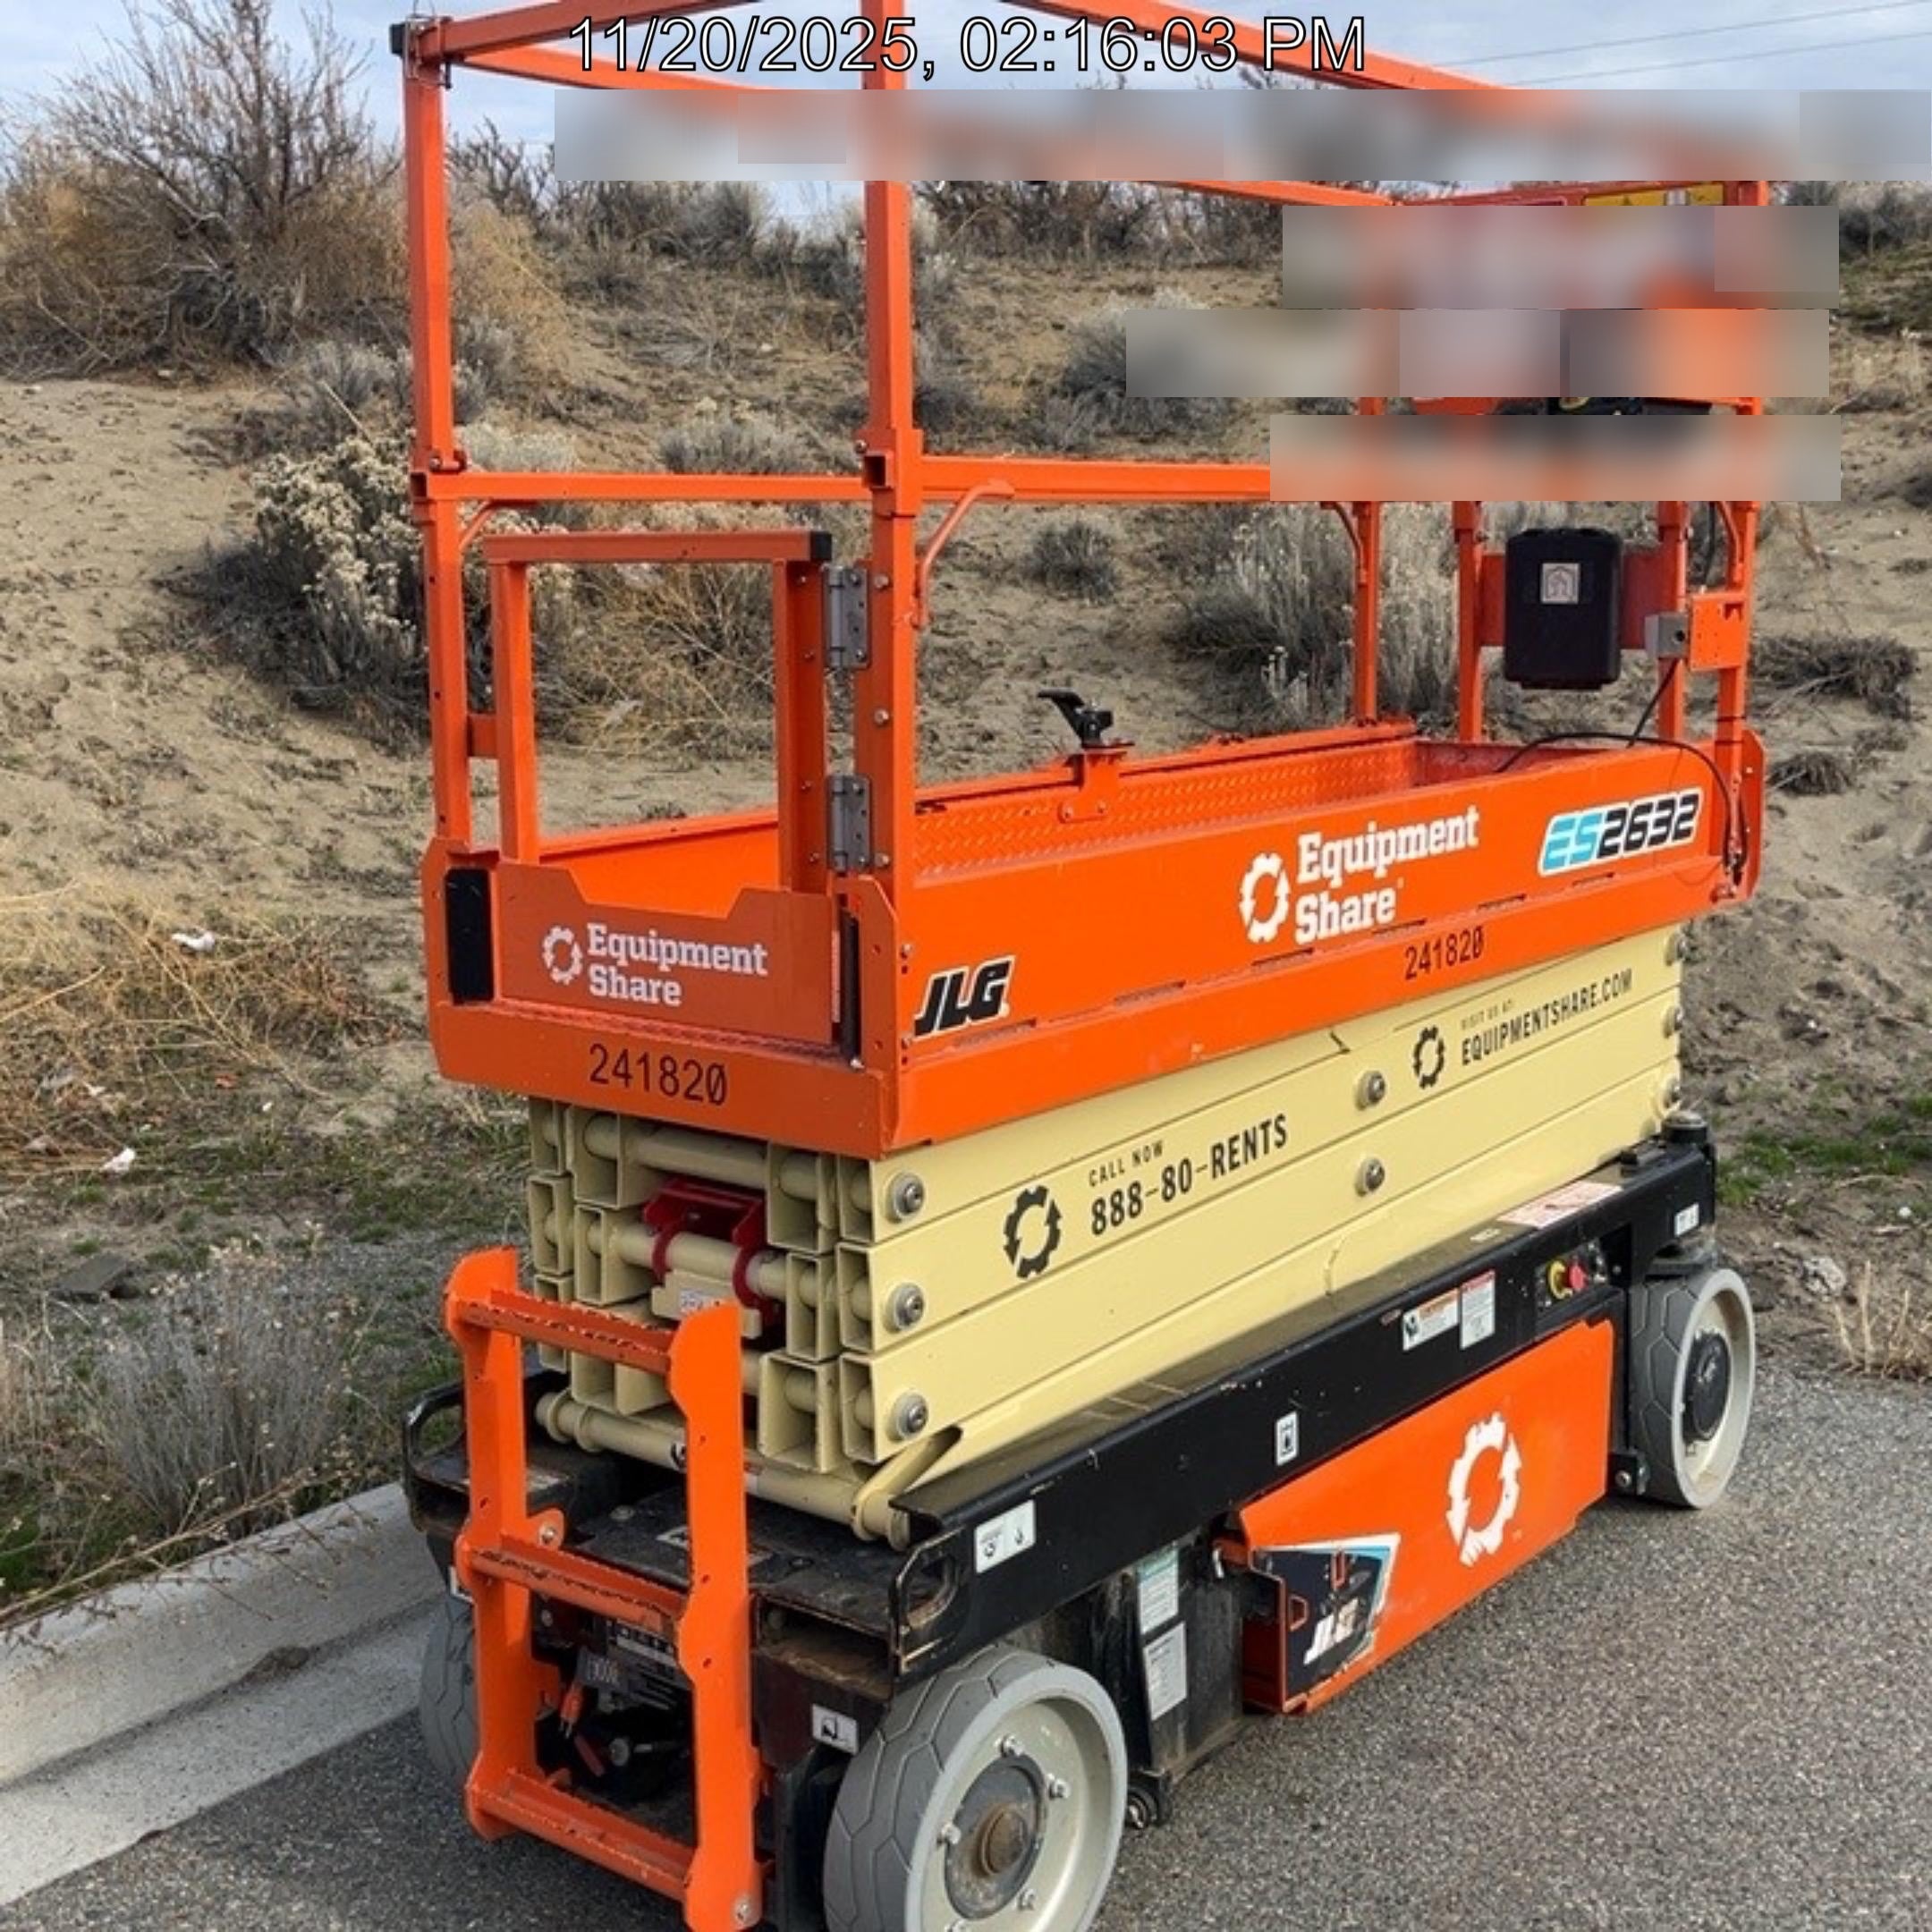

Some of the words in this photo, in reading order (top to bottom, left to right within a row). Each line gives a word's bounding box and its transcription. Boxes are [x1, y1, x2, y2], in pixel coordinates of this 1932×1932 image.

[1297, 804, 1480, 888] Equipment
[1540, 792, 1700, 871] ES2632
[1295, 886, 1397, 945] Share
[586, 921, 768, 977] Equipment
[1404, 925, 1485, 981] 241820
[589, 963, 682, 1007] Share
[913, 957, 1013, 1038] JLG
[1462, 968, 1633, 1066] EQUIPMENTSHARE.COM
[589, 1042, 728, 1106] 241820
[1088, 1158, 1125, 1188] CALL
[1131, 1139, 1164, 1167] NOW
[1090, 1113, 1288, 1236] 888-80-RENTS
